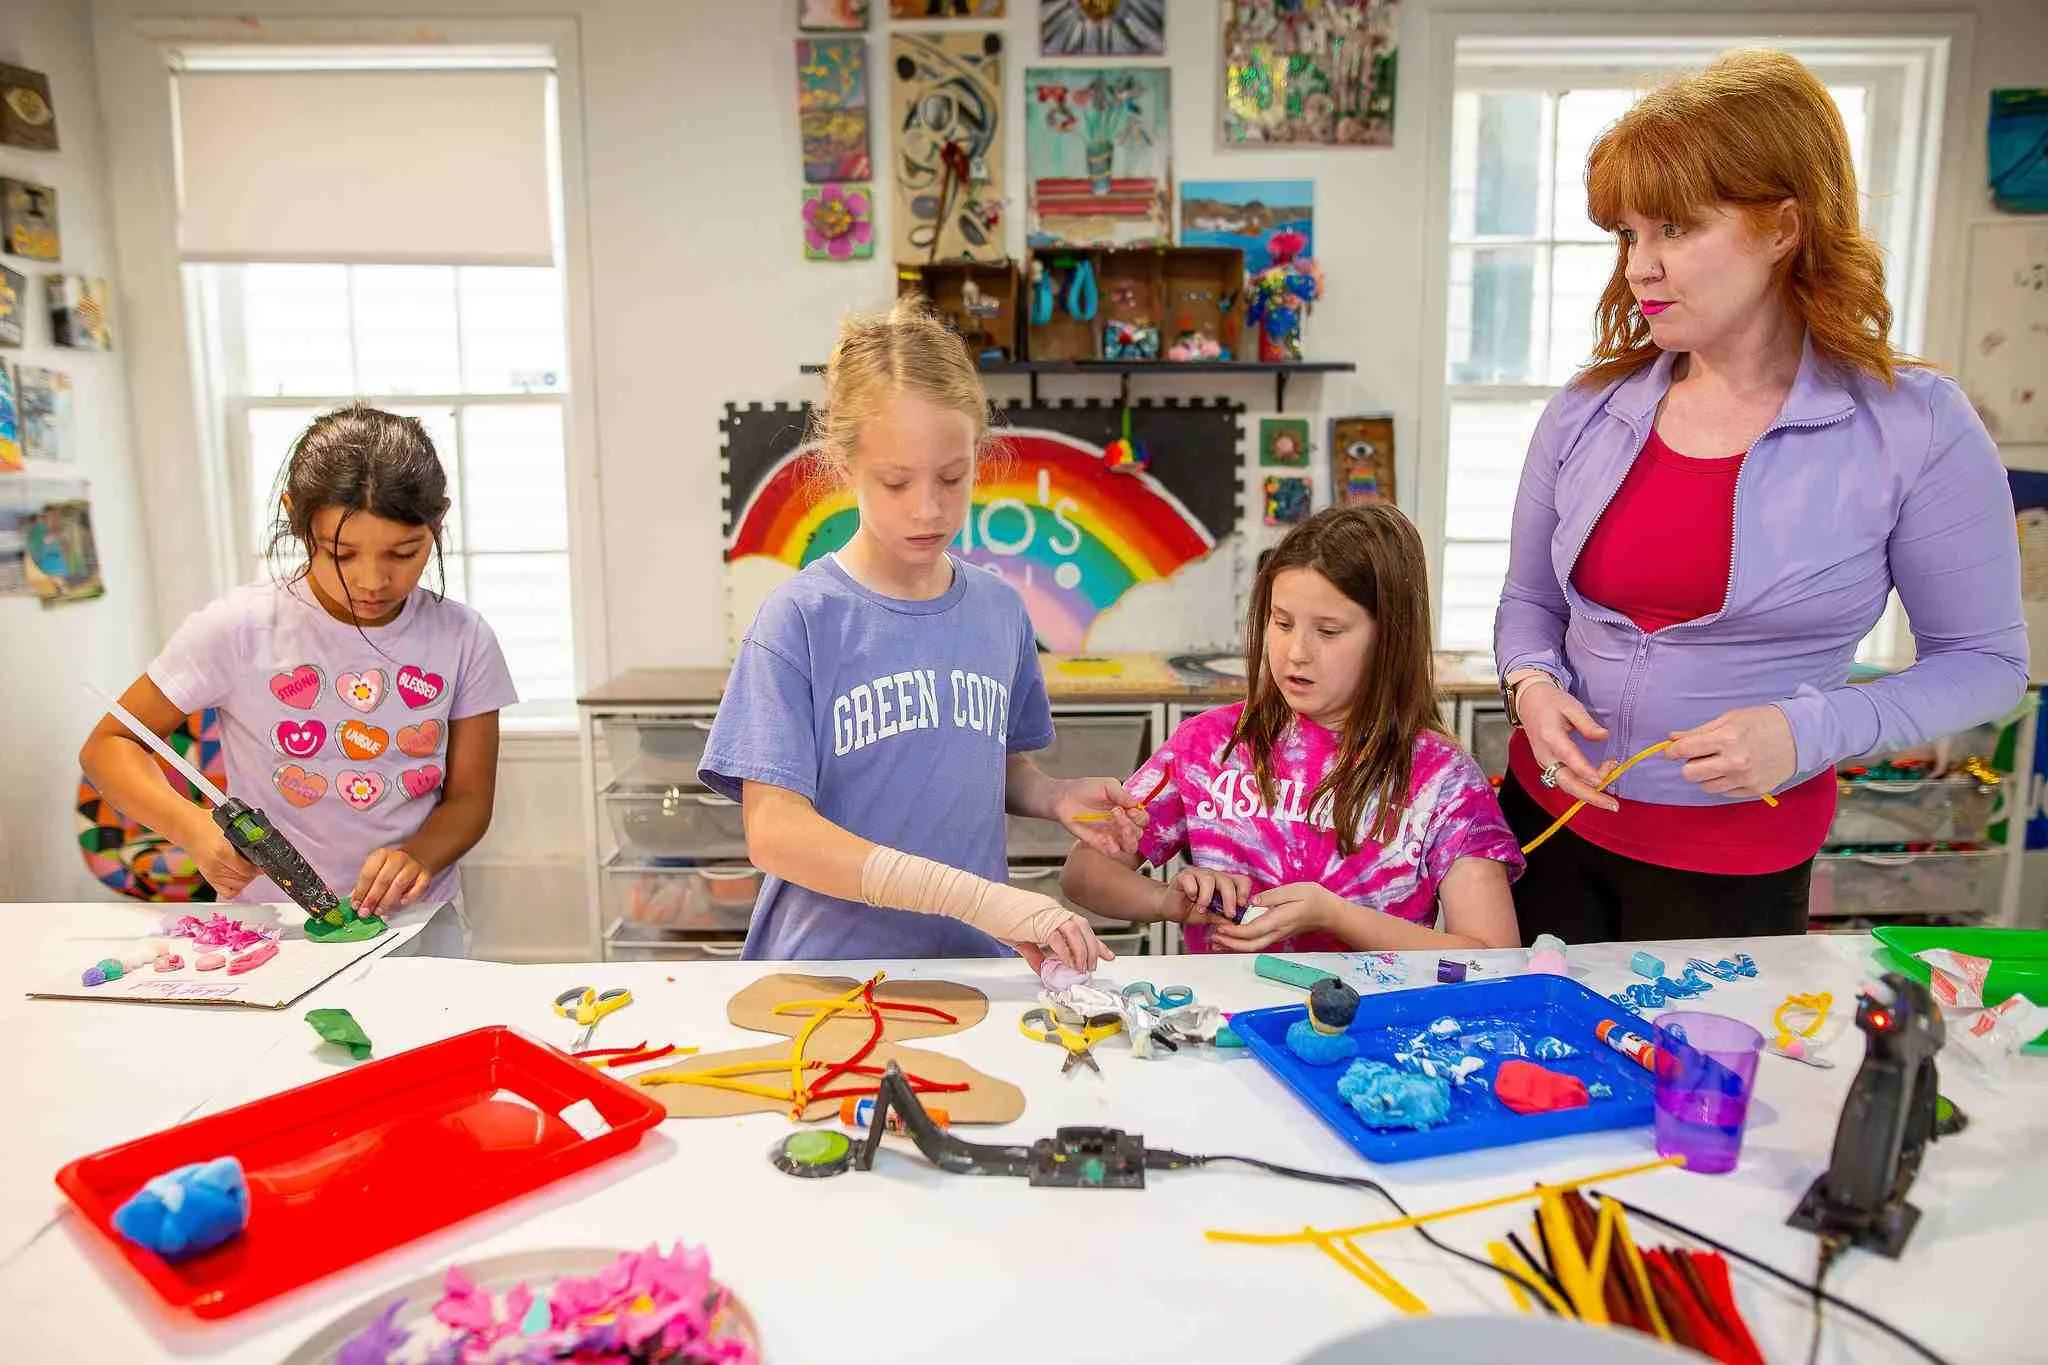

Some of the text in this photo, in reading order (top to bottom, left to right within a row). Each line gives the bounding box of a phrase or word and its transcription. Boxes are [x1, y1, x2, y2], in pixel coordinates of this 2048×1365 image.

[398, 674, 438, 699] BLESSED
[834, 670, 939, 756] GREEN
[346, 730, 381, 755] UNIQUE
